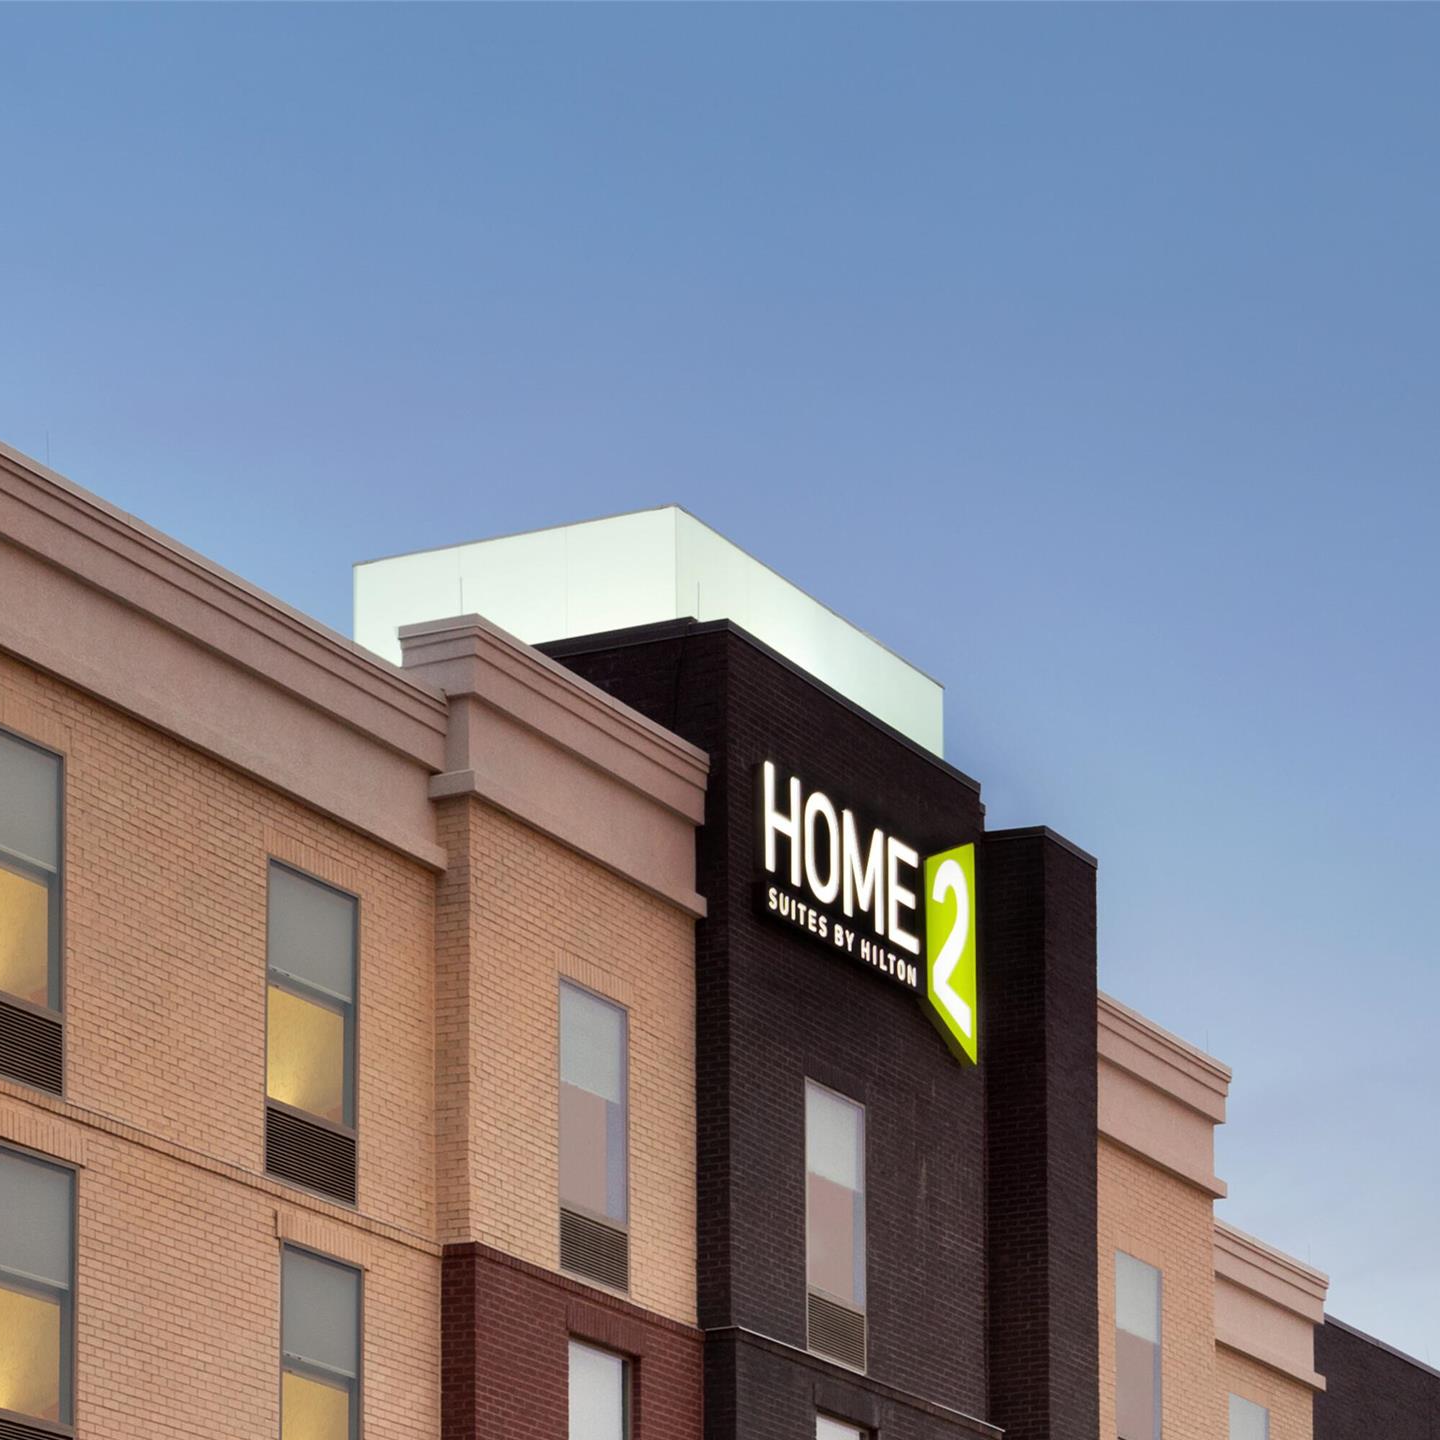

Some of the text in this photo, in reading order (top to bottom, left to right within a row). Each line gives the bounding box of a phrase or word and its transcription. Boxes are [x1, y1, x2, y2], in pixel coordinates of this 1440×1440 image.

[764, 760, 972, 1039] HOME 2
[768, 887, 917, 987] SUITES BY HILTON
